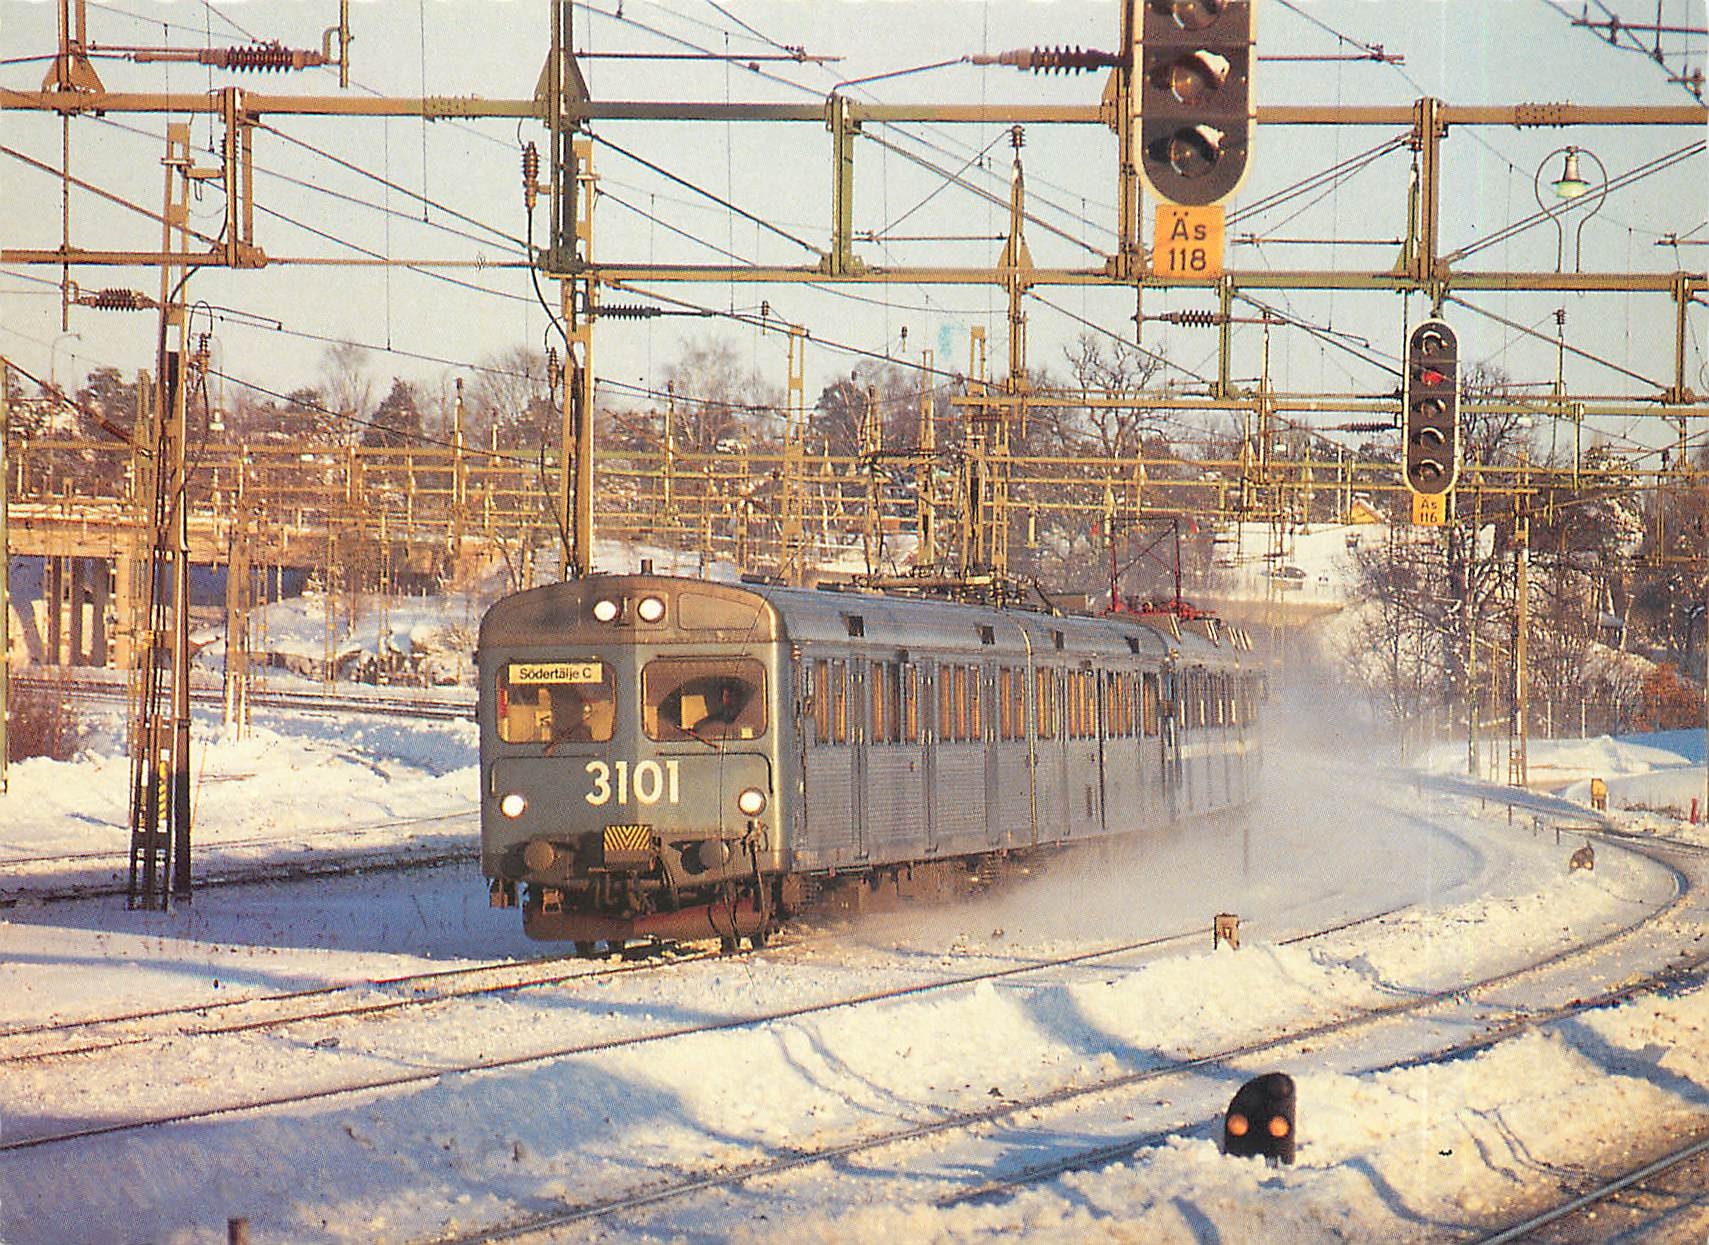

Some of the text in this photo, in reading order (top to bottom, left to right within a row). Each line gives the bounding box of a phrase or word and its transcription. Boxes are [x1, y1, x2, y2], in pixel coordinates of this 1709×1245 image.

[1171, 211, 1207, 241] Äs
[1168, 248, 1207, 271] 118
[1421, 496, 1438, 510] Äs
[1420, 512, 1438, 523] 116
[519, 667, 592, 680] Södertälje C
[585, 760, 679, 806] 3101
